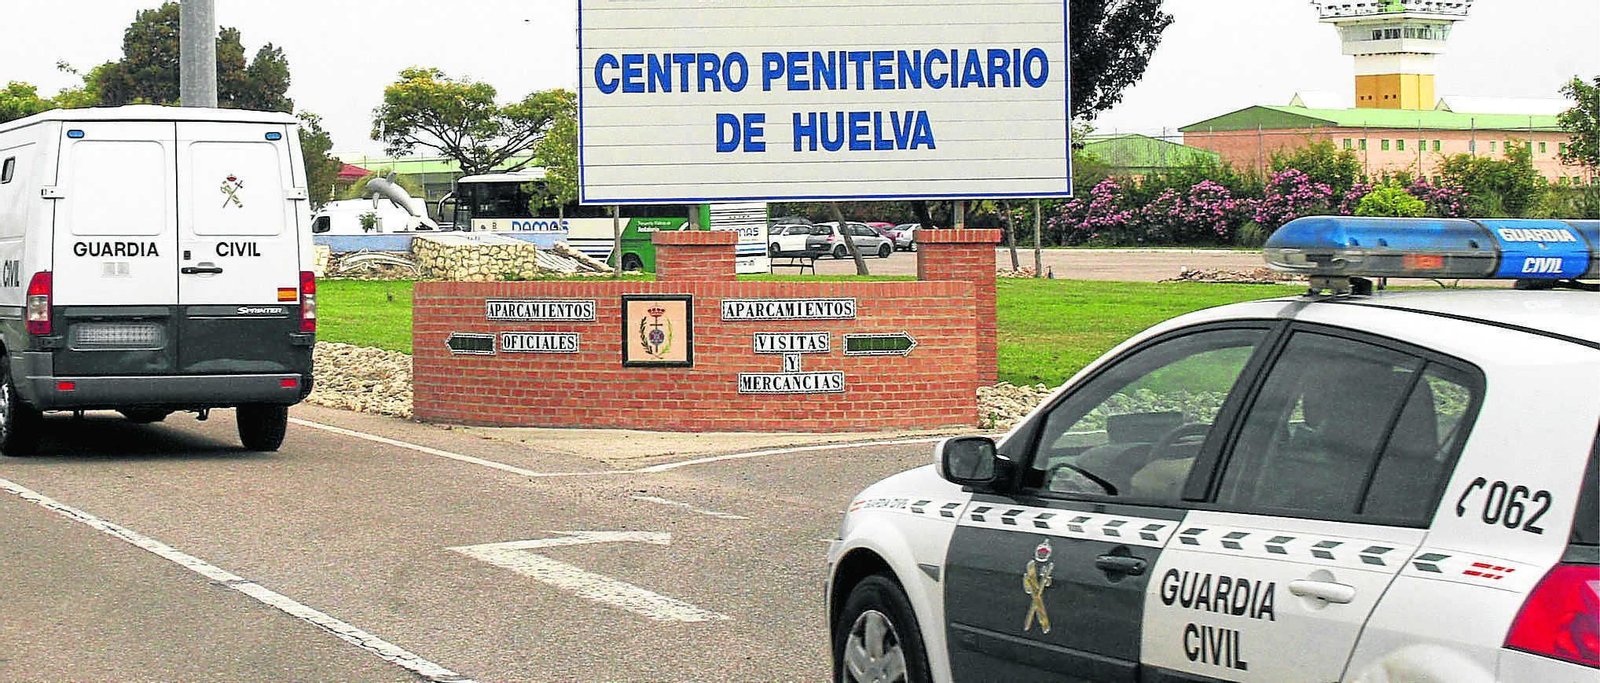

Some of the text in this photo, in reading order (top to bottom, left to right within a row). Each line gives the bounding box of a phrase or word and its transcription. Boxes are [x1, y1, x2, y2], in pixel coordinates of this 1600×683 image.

[594, 47, 1050, 95] CENTRO PENITENCIARIO
[716, 110, 936, 153] DE HUELVA
[1498, 228, 1577, 243] GUARDIA
[73, 241, 261, 257] GUARDIA CIVIL
[3, 259, 19, 288] CIVIL
[1521, 257, 1563, 274] CIVIL
[488, 303, 592, 318] APARCAMIENTOS
[725, 301, 853, 317] APARCAMIENTOS
[503, 335, 576, 350] OFICIALES
[757, 334, 827, 350] VISITAS
[787, 356, 797, 371] Y
[742, 374, 841, 391] MERCANCIAS
[1482, 480, 1553, 535] 062
[1160, 568, 1276, 622] GUARDIA
[1183, 623, 1248, 671] CIVIL
